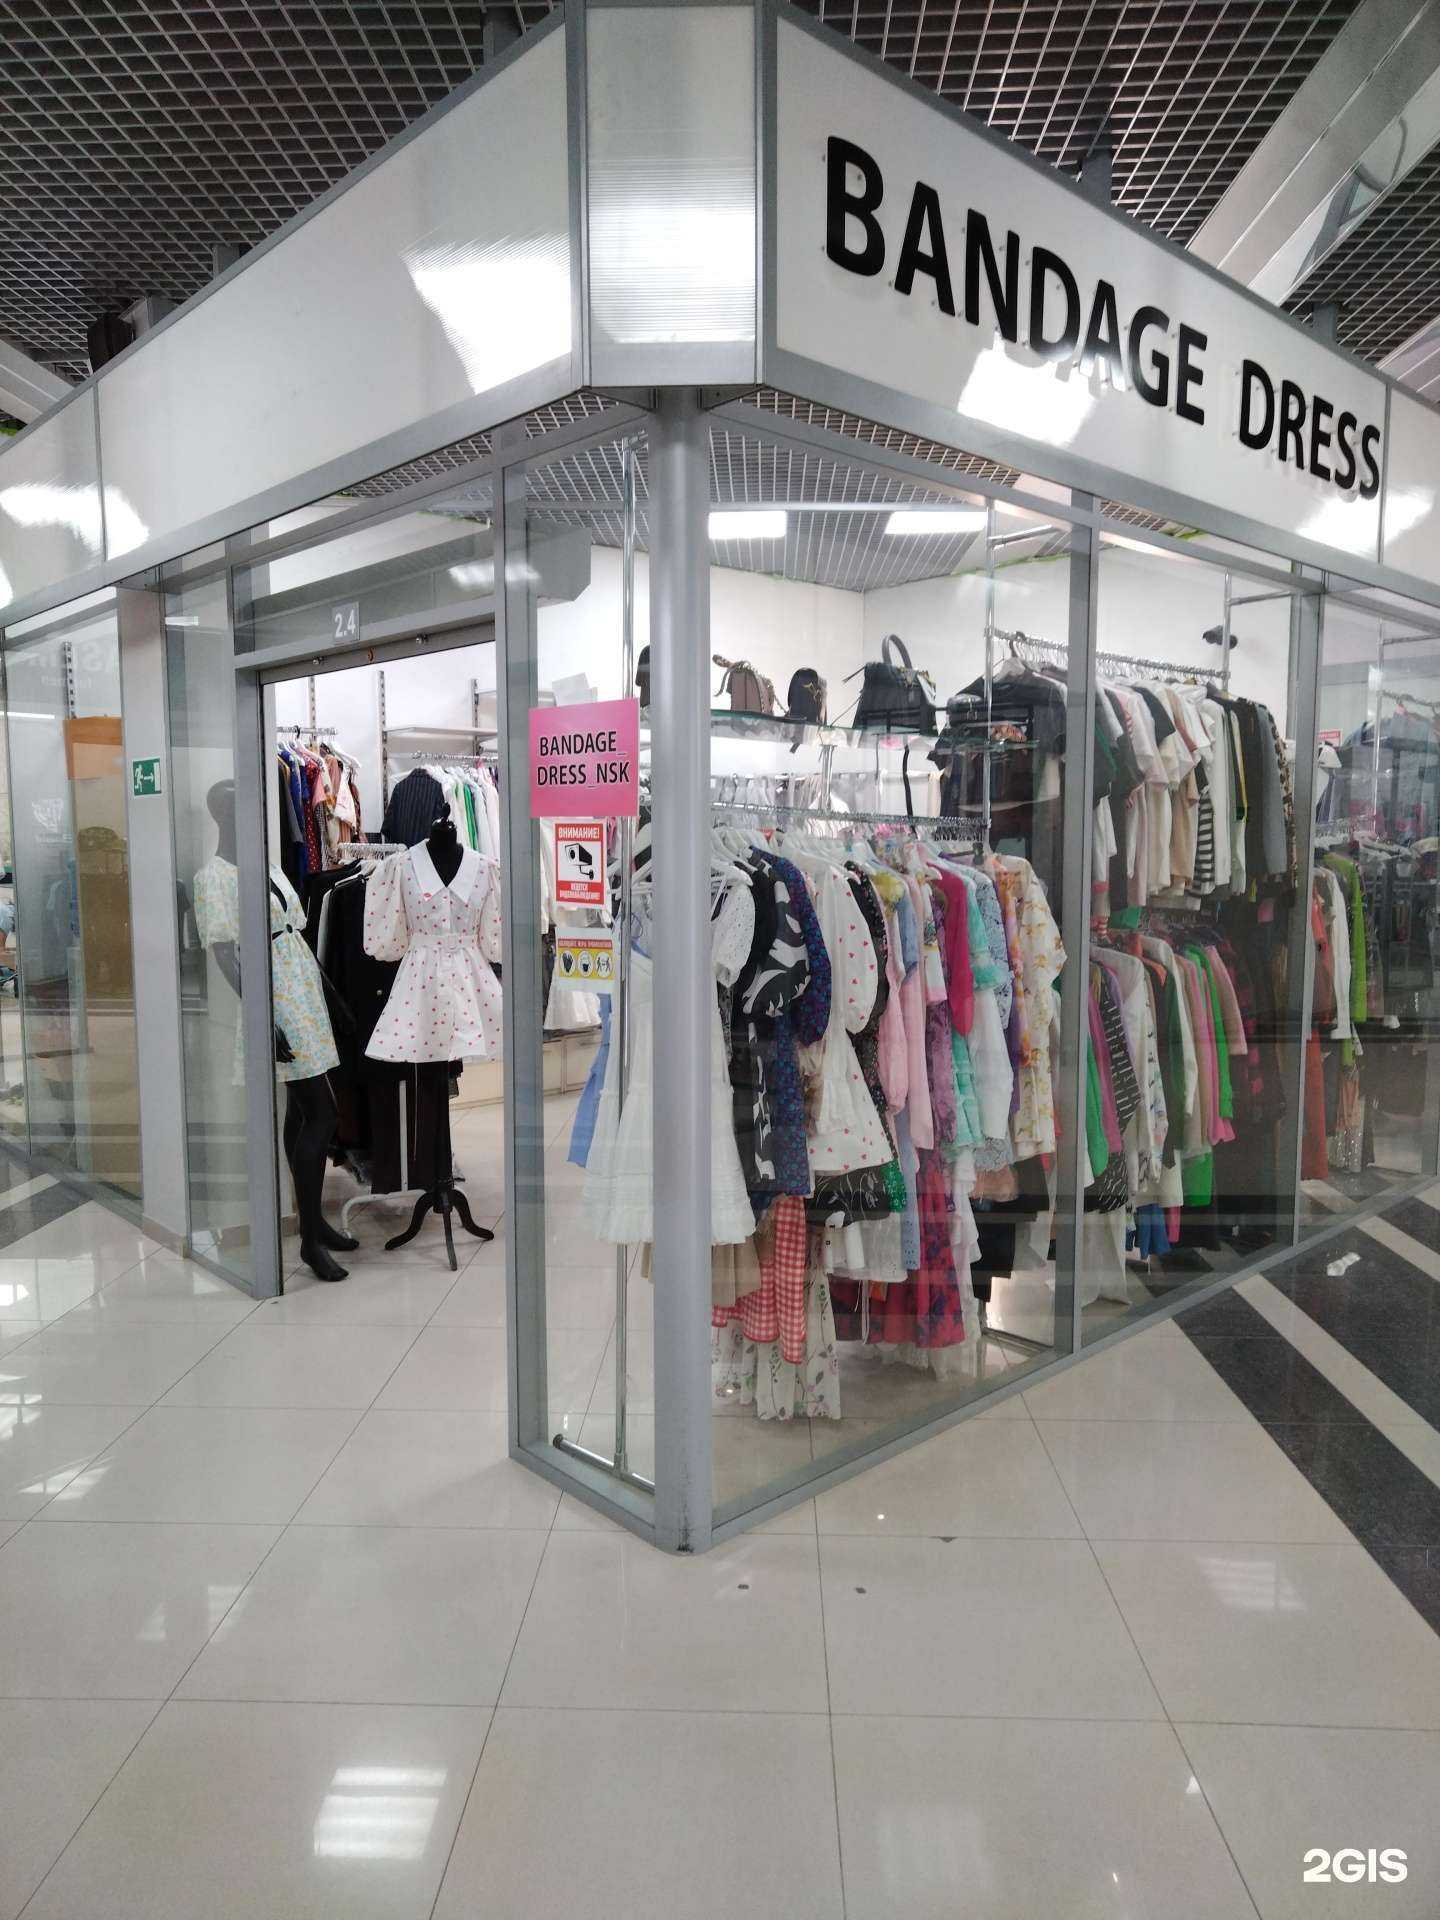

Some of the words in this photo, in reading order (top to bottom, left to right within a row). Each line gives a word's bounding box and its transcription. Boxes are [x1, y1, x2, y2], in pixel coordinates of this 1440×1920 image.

[826, 135, 1208, 426] BANDAGE
[1239, 359, 1381, 500] DRESS
[334, 609, 356, 638] 2.4
